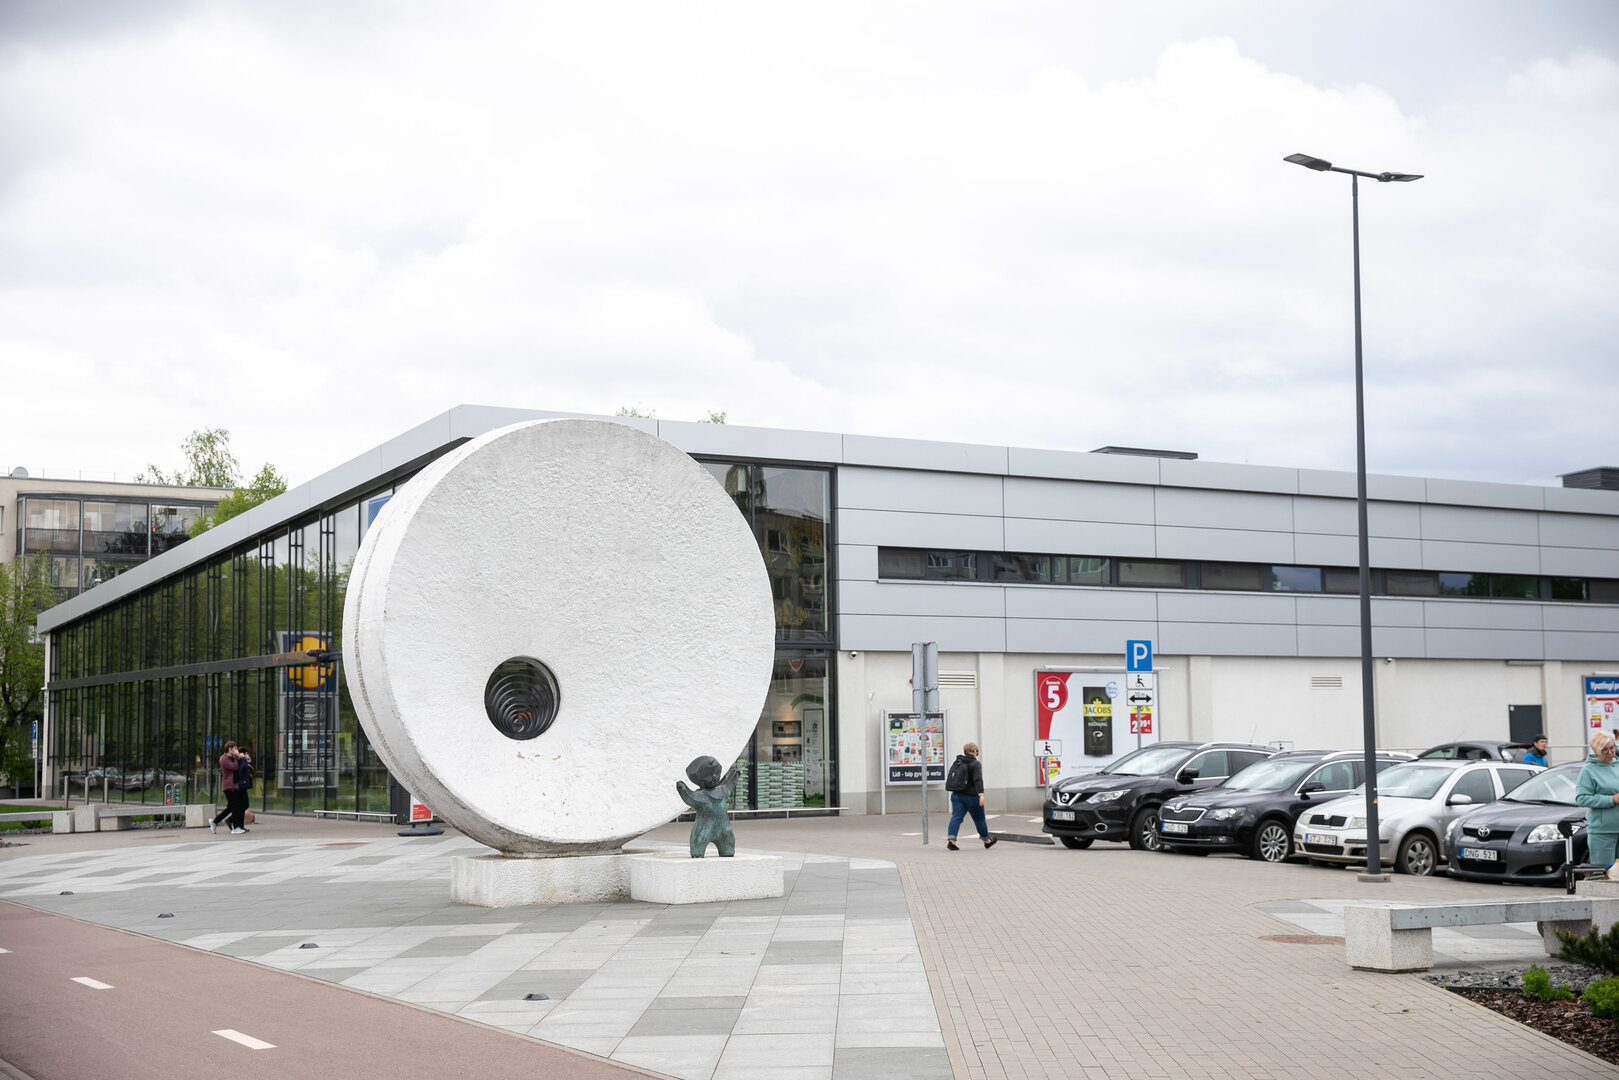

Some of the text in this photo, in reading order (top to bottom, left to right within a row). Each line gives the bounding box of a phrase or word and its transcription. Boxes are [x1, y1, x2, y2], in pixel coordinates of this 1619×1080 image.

[1133, 642, 1148, 669] P
[1047, 685, 1060, 709] 5
[1084, 706, 1112, 715] JACOBS
[1465, 849, 1496, 859] DNG 521
